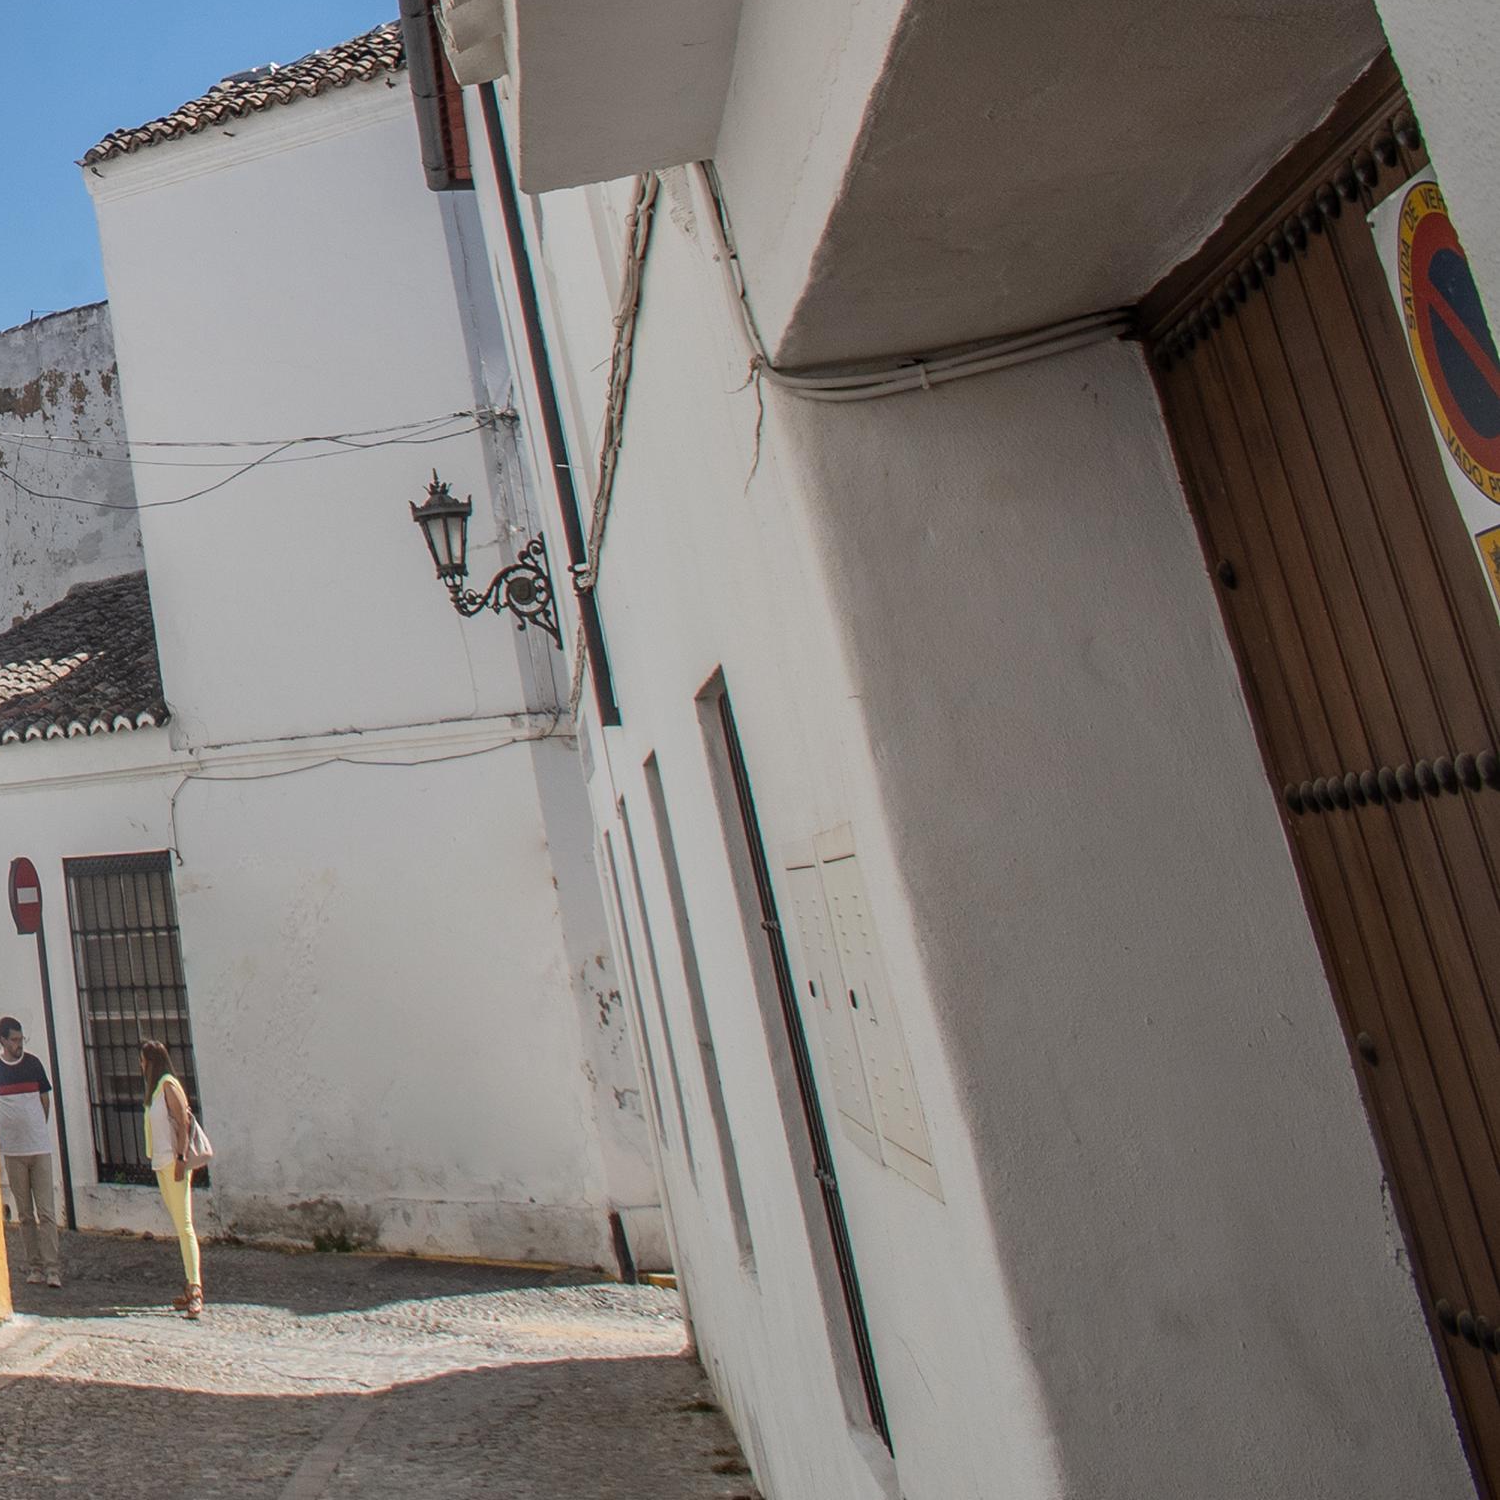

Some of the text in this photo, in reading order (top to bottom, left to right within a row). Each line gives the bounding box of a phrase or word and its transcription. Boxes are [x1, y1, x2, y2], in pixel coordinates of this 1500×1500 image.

[1402, 200, 1419, 232] DE
[1400, 238, 1417, 331] SALIDA
[1446, 425, 1484, 488] VADO
